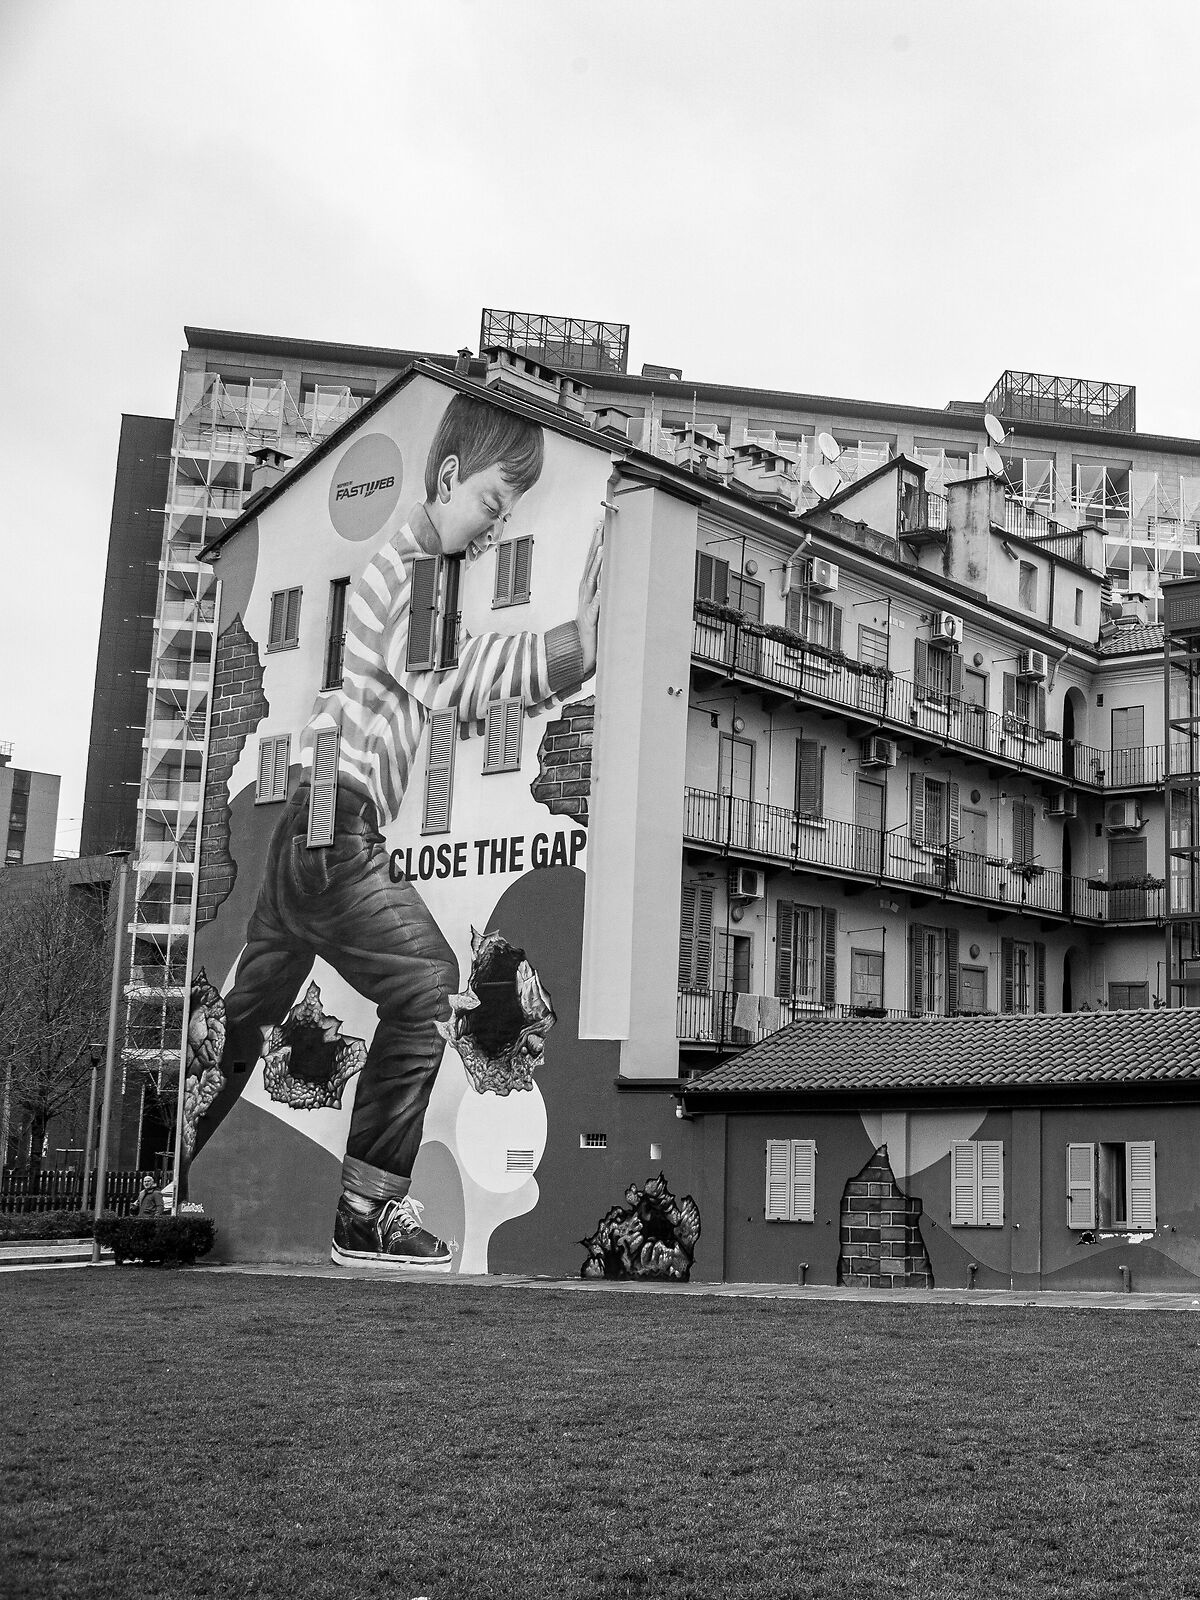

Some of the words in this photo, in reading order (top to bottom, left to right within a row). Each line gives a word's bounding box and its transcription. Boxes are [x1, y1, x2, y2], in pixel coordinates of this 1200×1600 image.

[336, 476, 395, 501] FASTWEB
[389, 842, 468, 883] CLOSE
[474, 835, 524, 876] THE
[531, 829, 587, 869] GAP
